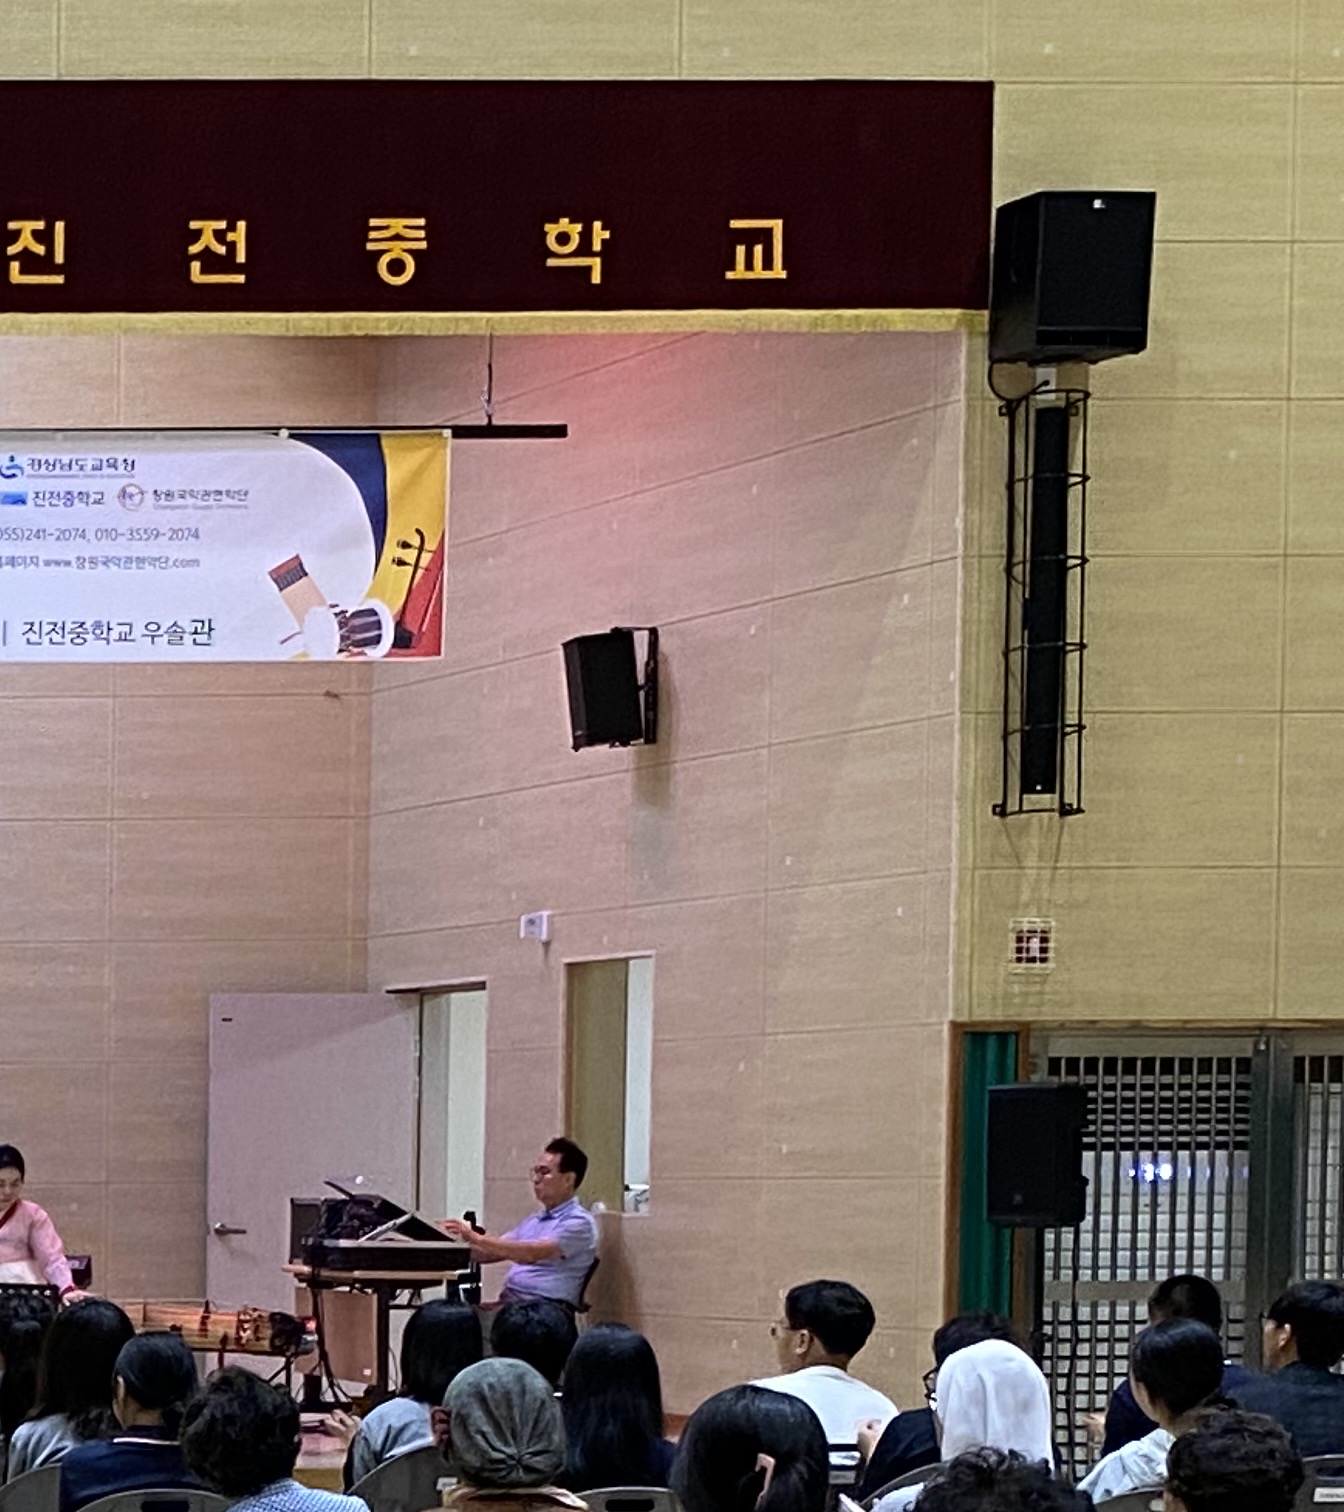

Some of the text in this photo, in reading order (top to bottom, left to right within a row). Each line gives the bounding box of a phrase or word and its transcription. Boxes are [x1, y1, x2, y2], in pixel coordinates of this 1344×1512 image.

[31, 490, 105, 508] 진전중학교
[94, 526, 201, 543] 010-3559-2074
[21, 619, 137, 647] 진전중학교
